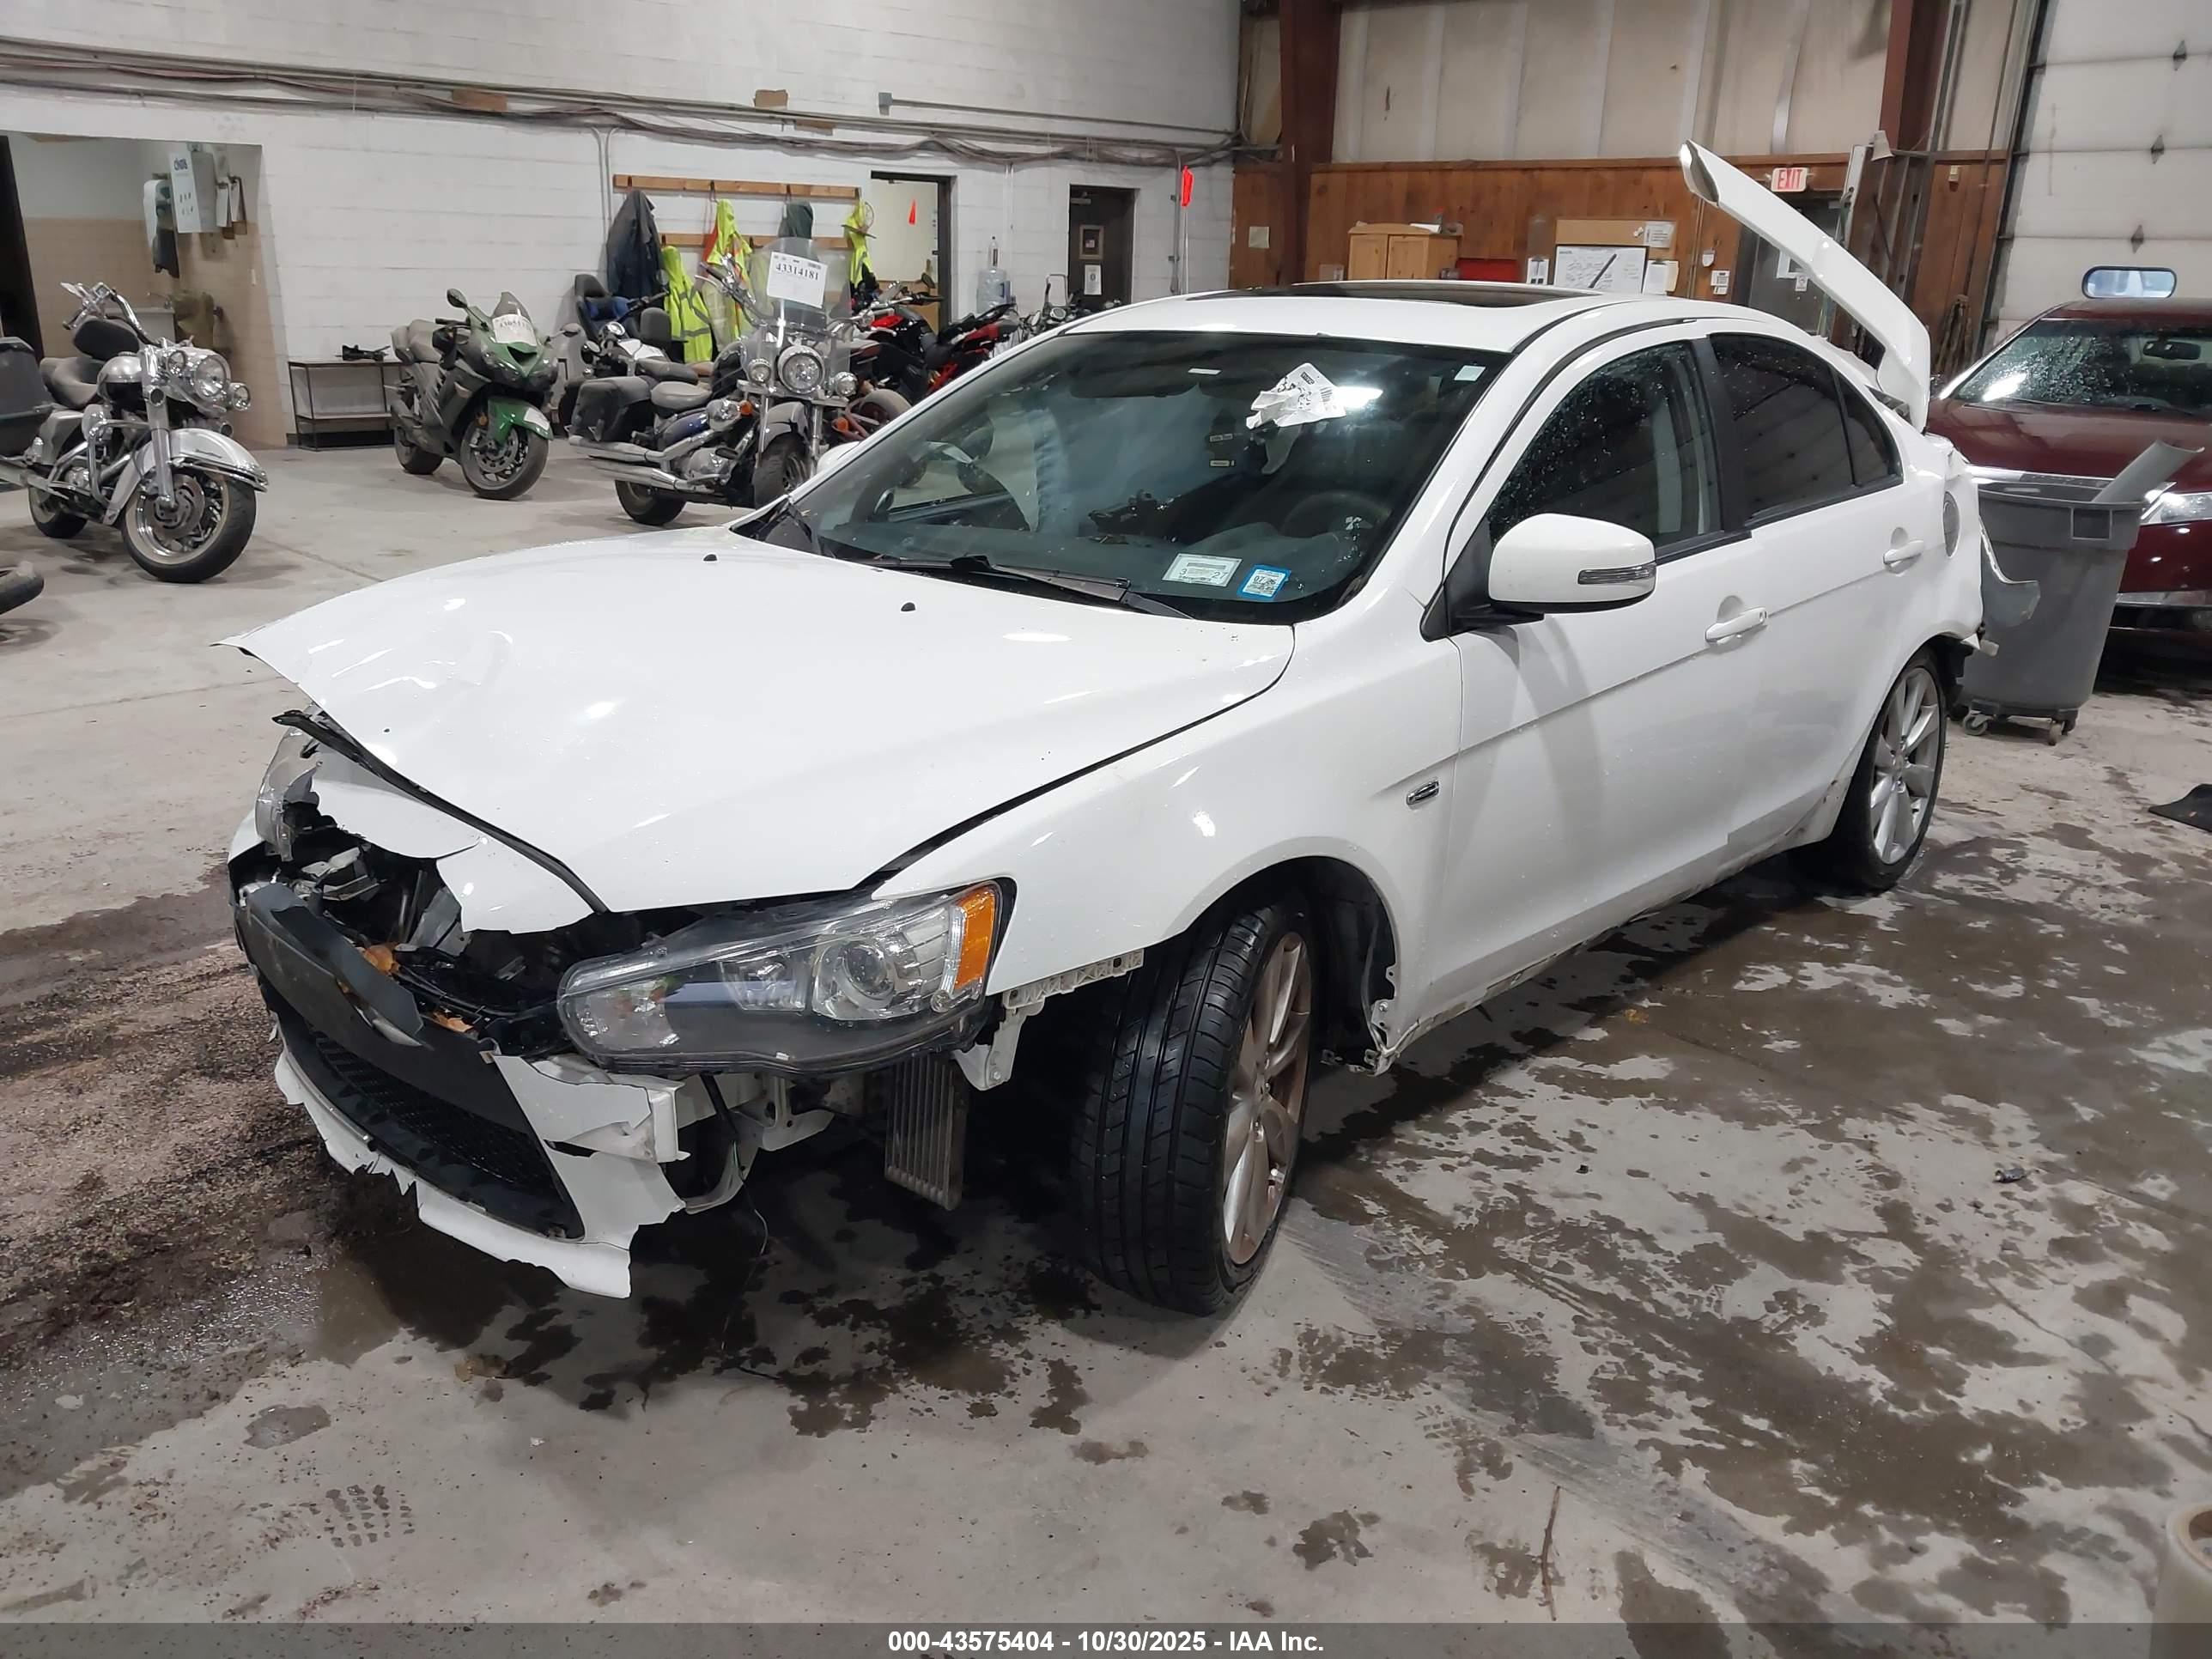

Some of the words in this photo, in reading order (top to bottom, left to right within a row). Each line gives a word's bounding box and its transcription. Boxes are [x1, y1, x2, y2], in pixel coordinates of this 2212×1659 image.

[1777, 168, 1803, 190] EXIT
[776, 263, 818, 281] 43314181
[1212, 571, 1229, 580] 27
